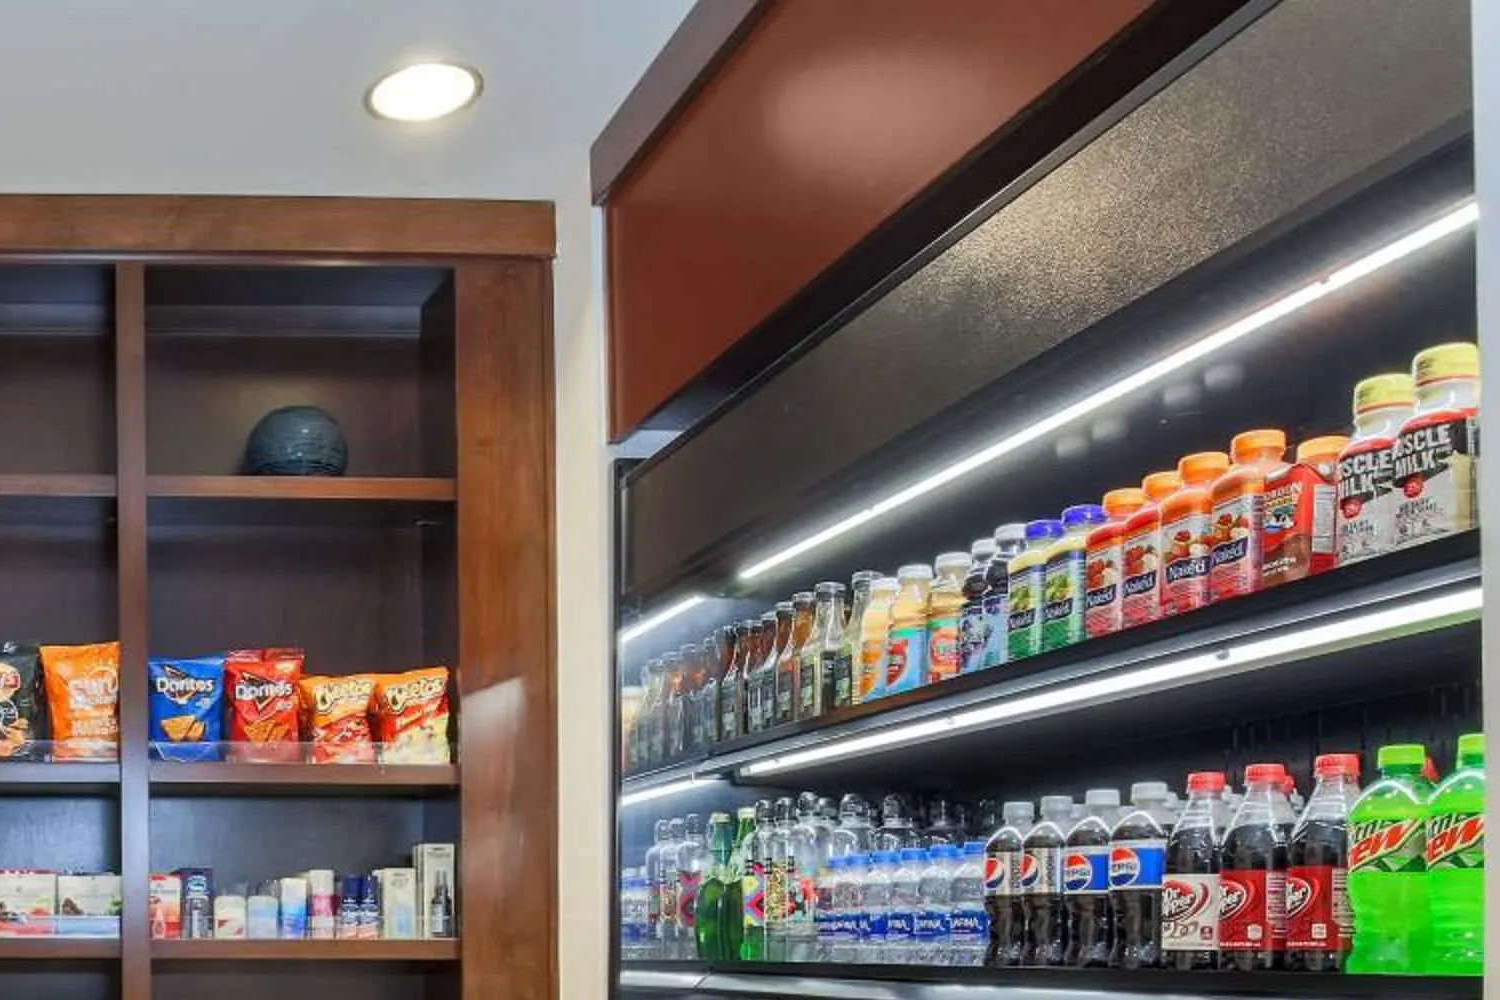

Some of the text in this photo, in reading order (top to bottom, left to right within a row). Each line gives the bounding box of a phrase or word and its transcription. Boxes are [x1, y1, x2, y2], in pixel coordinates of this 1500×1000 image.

[1341, 449, 1395, 478] SCLE
[156, 677, 214, 693] Doritos
[235, 681, 293, 700] Doritos
